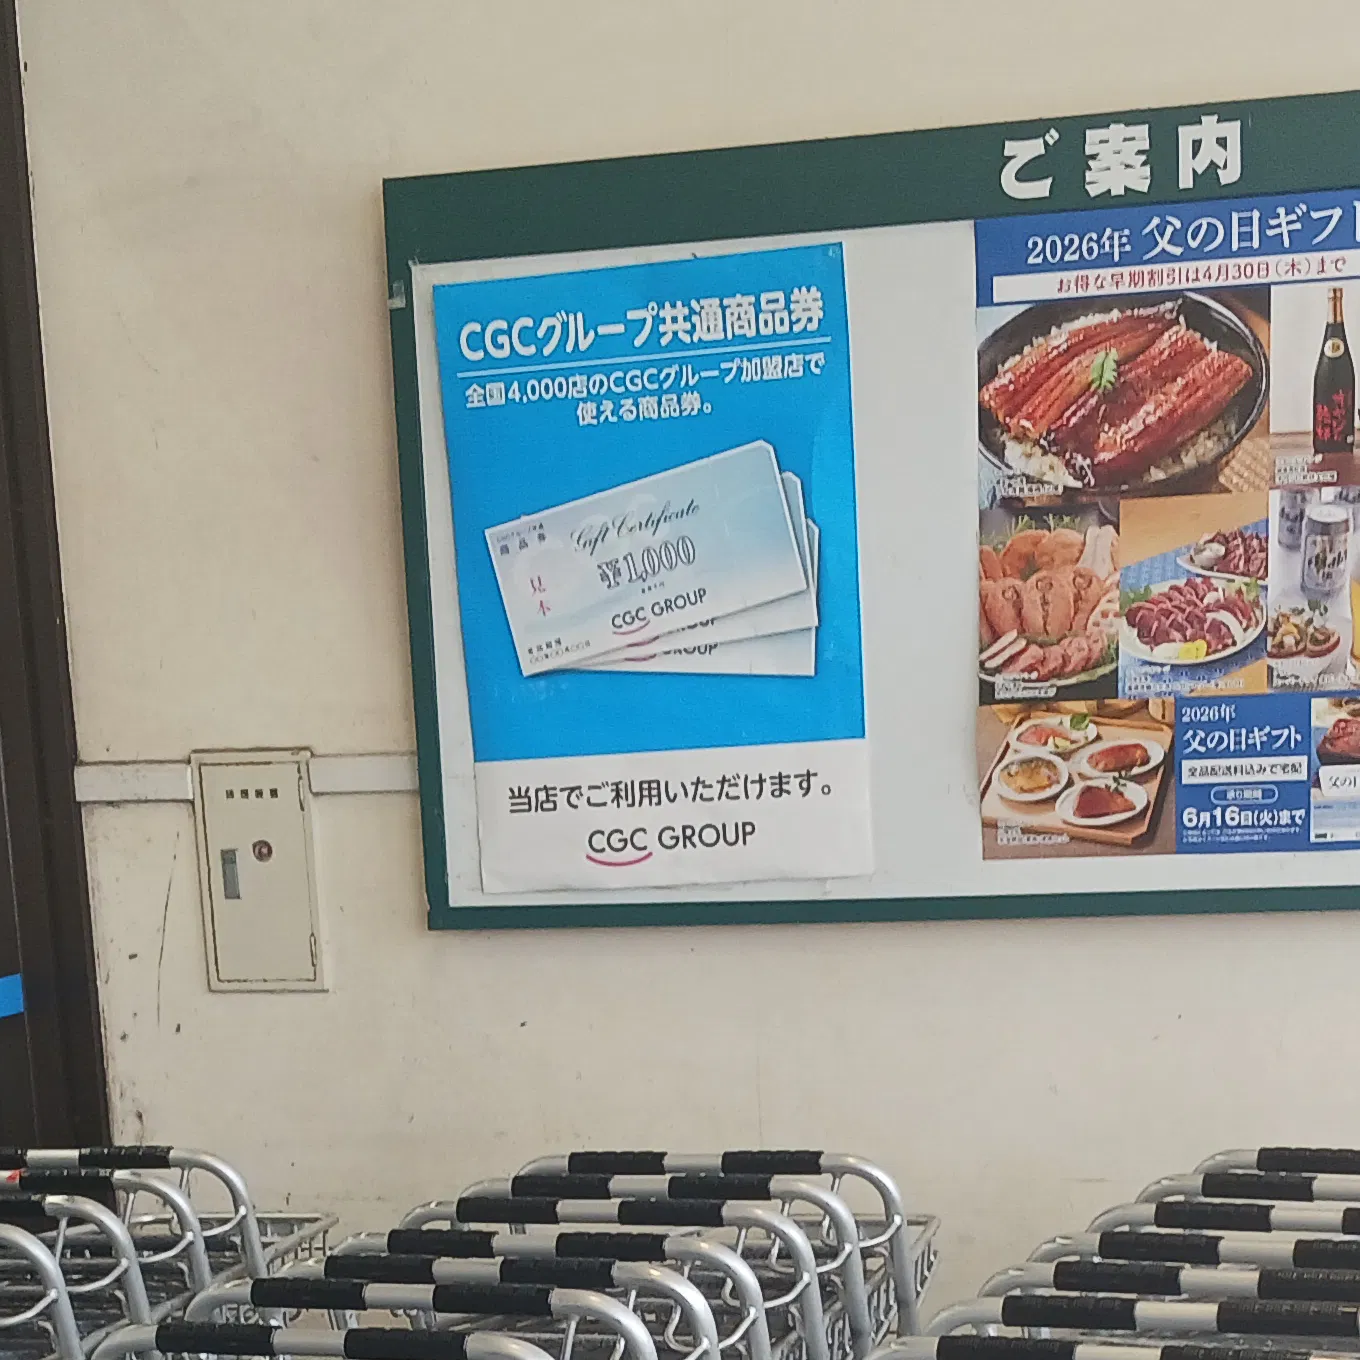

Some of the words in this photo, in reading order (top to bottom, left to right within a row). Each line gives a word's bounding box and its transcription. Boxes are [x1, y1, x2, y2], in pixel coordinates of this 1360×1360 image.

[1000, 114, 1241, 200] ご案内
[1027, 227, 1131, 265] 2026年
[459, 285, 824, 361] CGCグループ共通商品券
[465, 353, 826, 409] 全国4,000店のCGCグループ加盟店で
[577, 392, 712, 427] 使える商品券。
[611, 607, 647, 630] CGC
[651, 587, 708, 617] GROUP
[1181, 703, 1235, 722] 2026年
[1182, 725, 1302, 754] 父の日ギフト
[508, 768, 832, 814] 当店でご利用いただけます。
[1182, 806, 1305, 829] 6月16日(火)まで
[588, 828, 649, 854] CGC
[658, 821, 756, 850] GROUP
